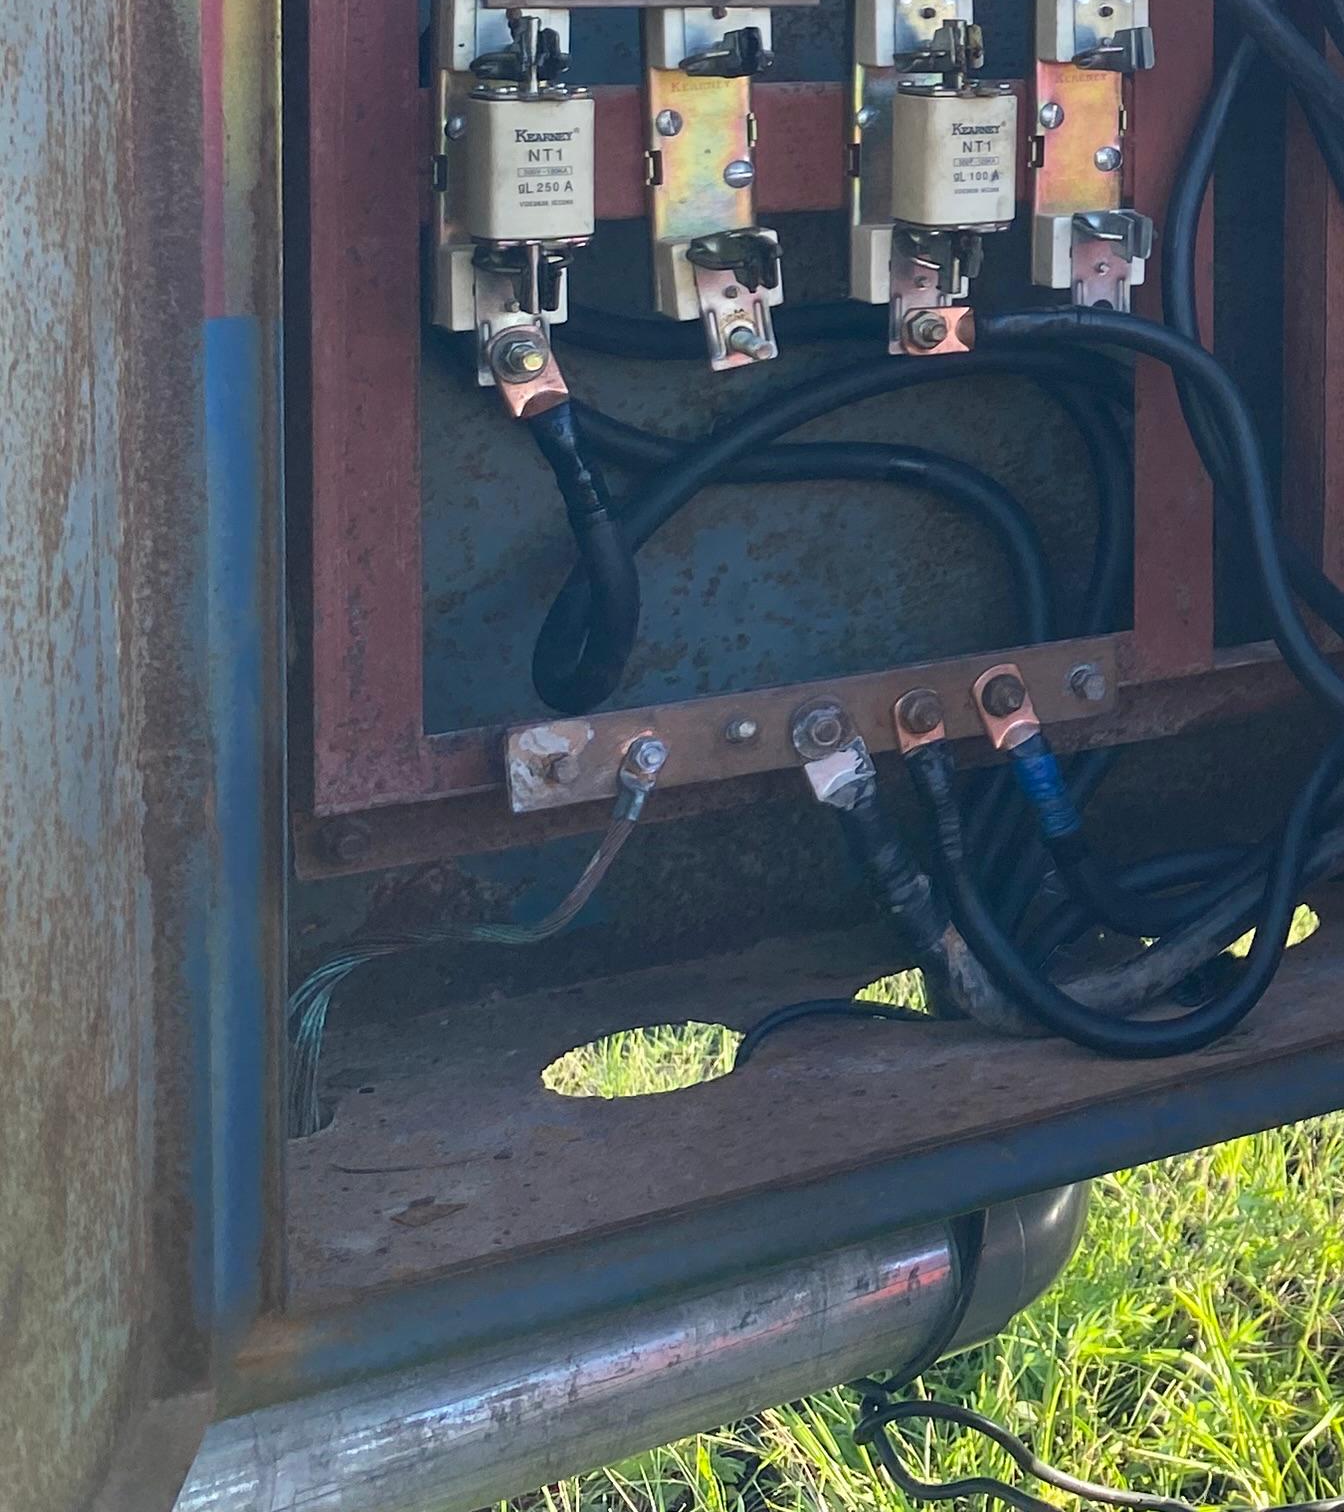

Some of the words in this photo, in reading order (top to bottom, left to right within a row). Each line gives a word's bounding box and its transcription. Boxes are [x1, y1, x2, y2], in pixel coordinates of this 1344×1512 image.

[962, 140, 992, 153] NT1
[528, 148, 563, 162] NT1
[970, 170, 988, 181] 100
[991, 169, 999, 182] A
[536, 182, 560, 193] 250
[564, 180, 573, 192] A
